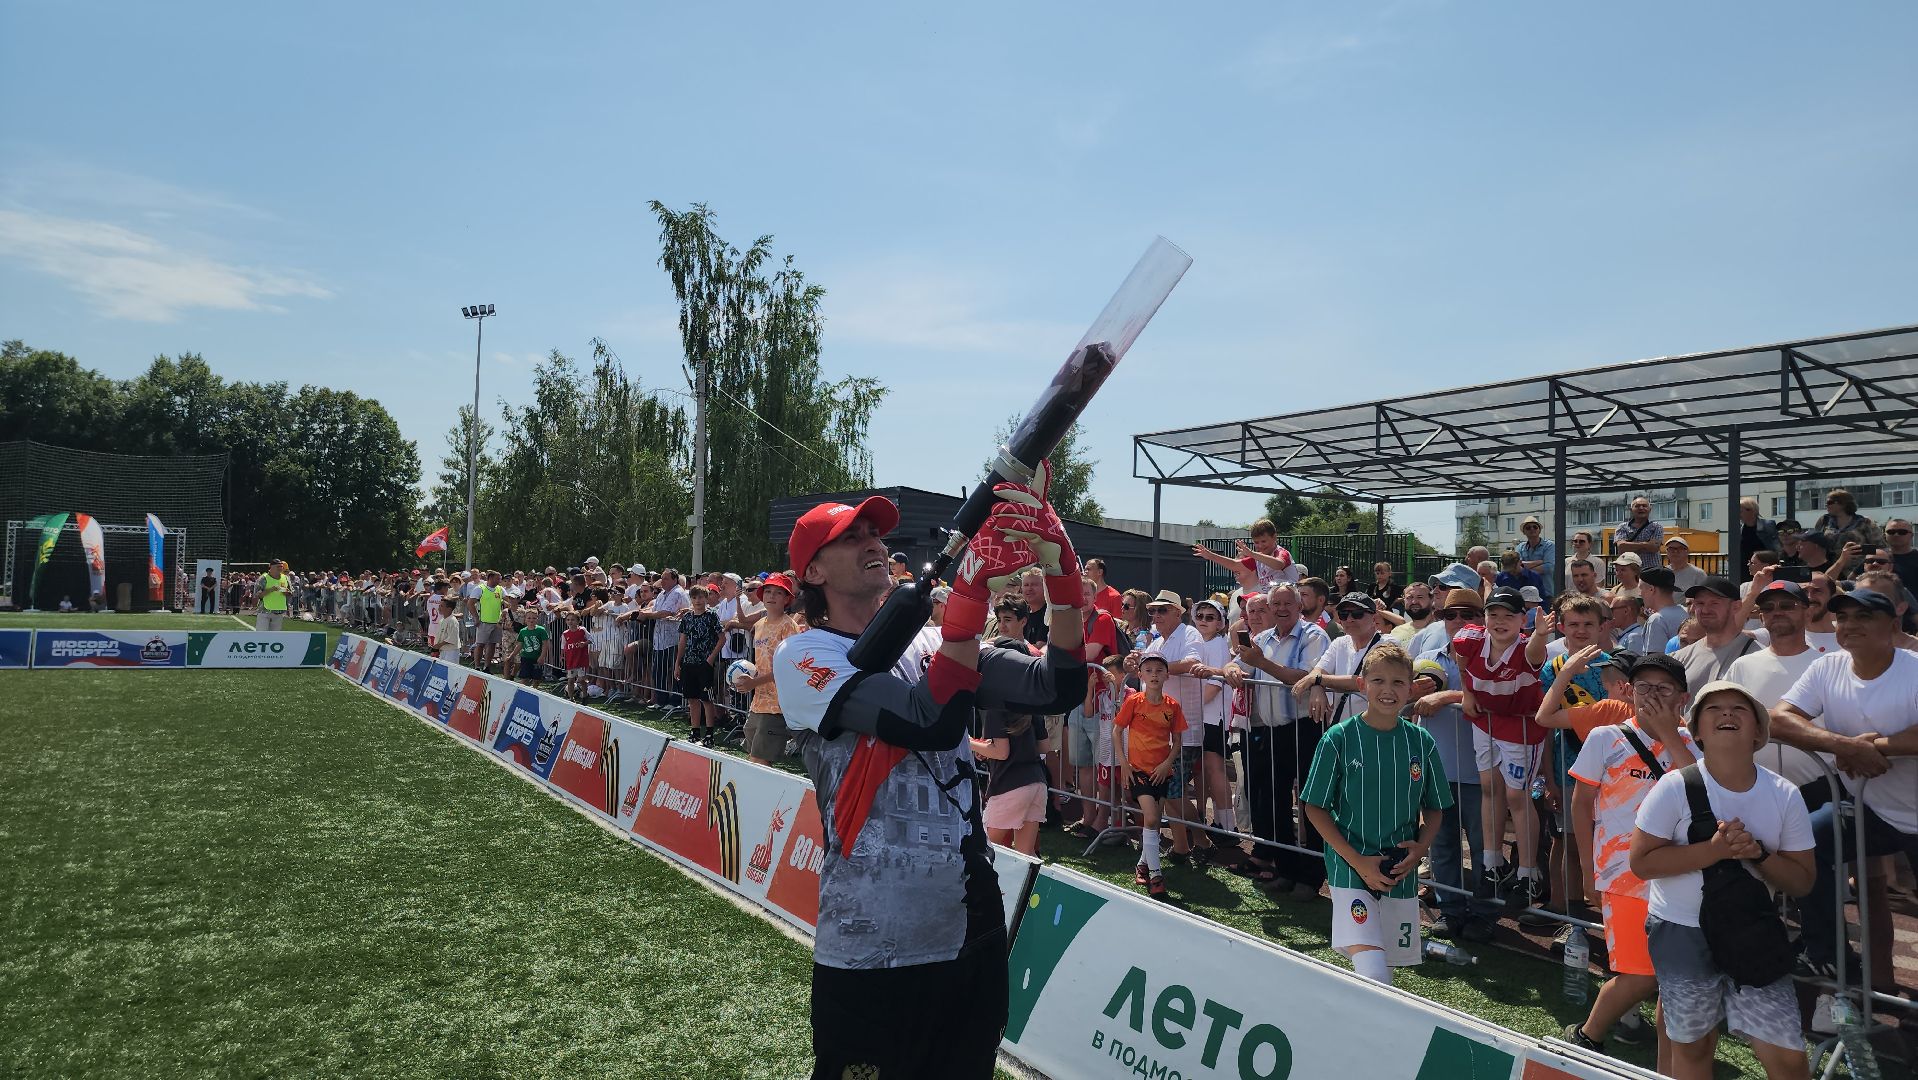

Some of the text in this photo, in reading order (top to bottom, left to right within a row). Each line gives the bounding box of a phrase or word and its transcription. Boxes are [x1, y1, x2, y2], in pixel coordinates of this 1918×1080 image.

[52, 640, 119, 648] МОСОБЛ
[52, 649, 113, 657] СПОРТ
[1508, 762, 1524, 779] 10
[1630, 768, 1656, 781] QIA
[663, 787, 703, 819] ПОБЕДА!
[789, 834, 825, 875] 80 ПО
[1398, 922, 1412, 948] 3
